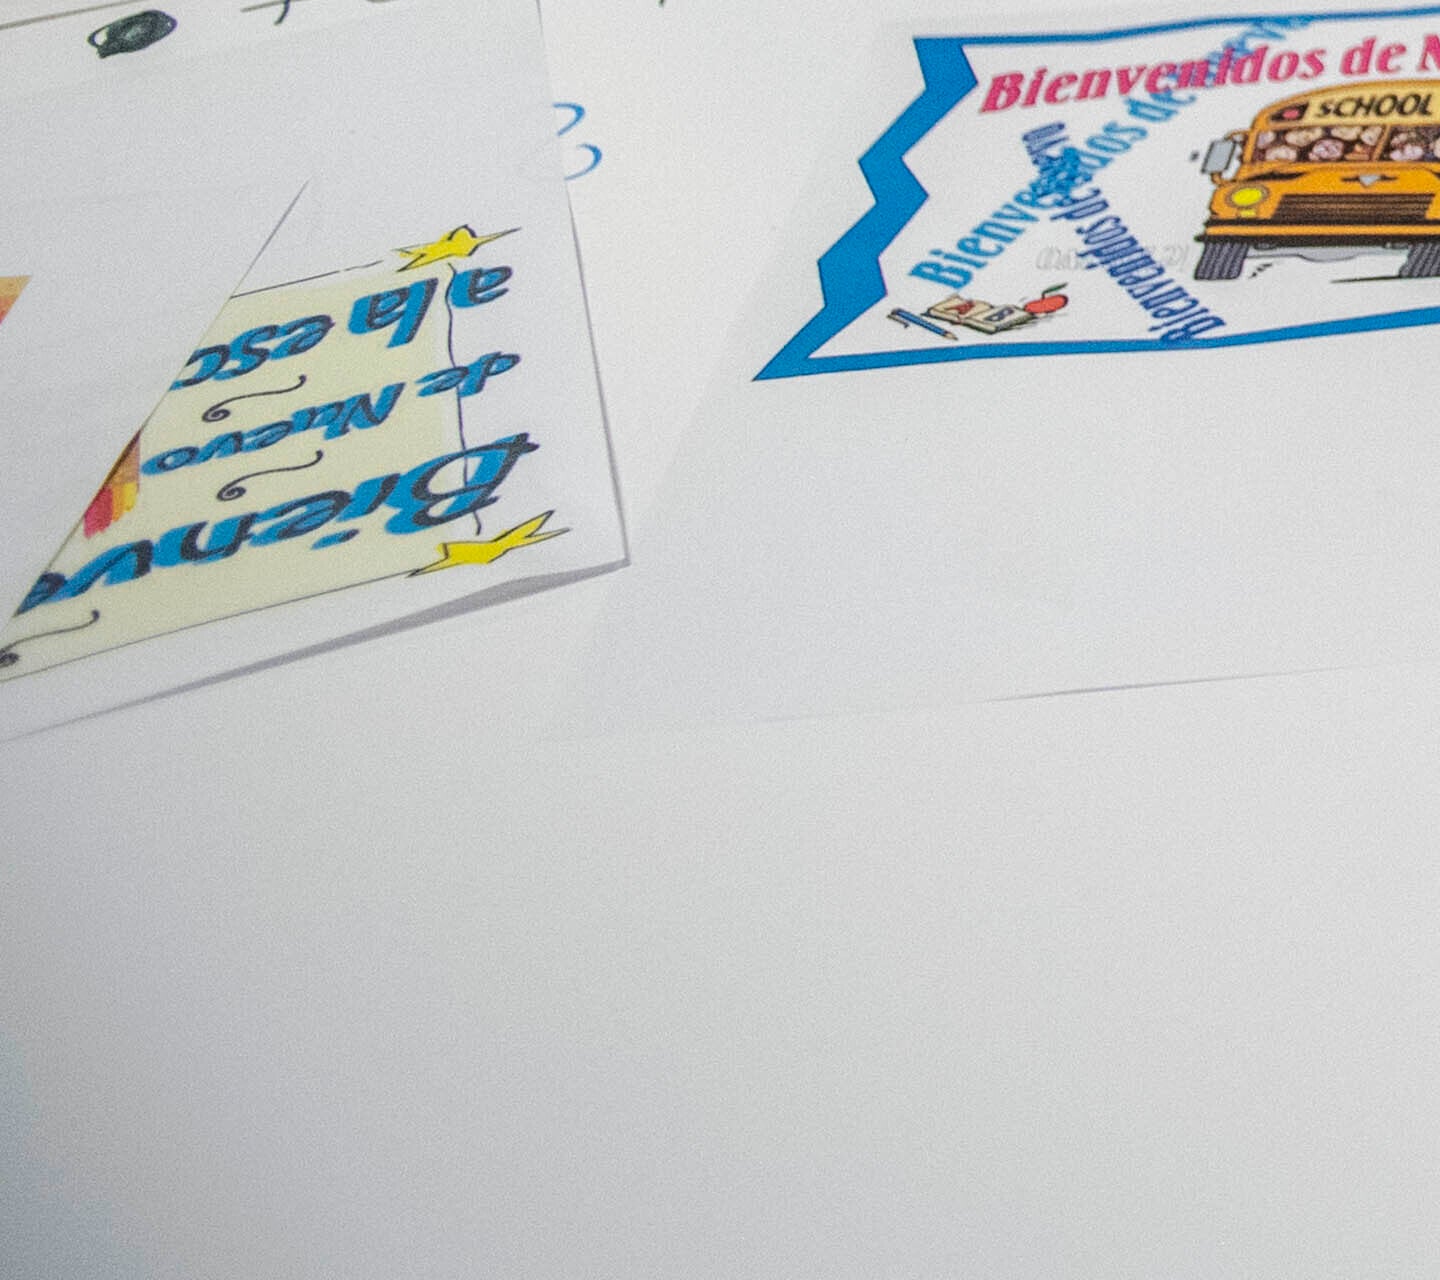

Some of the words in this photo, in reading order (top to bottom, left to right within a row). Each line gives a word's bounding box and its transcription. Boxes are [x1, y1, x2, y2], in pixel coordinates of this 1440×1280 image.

[979, 46, 1327, 114] Bienvenidos
[1339, 36, 1407, 76] de
[1316, 93, 1433, 119] SCHOOL
[347, 278, 439, 348] la
[450, 264, 513, 309] a
[414, 350, 523, 400] de
[141, 380, 405, 476] Nuevo
